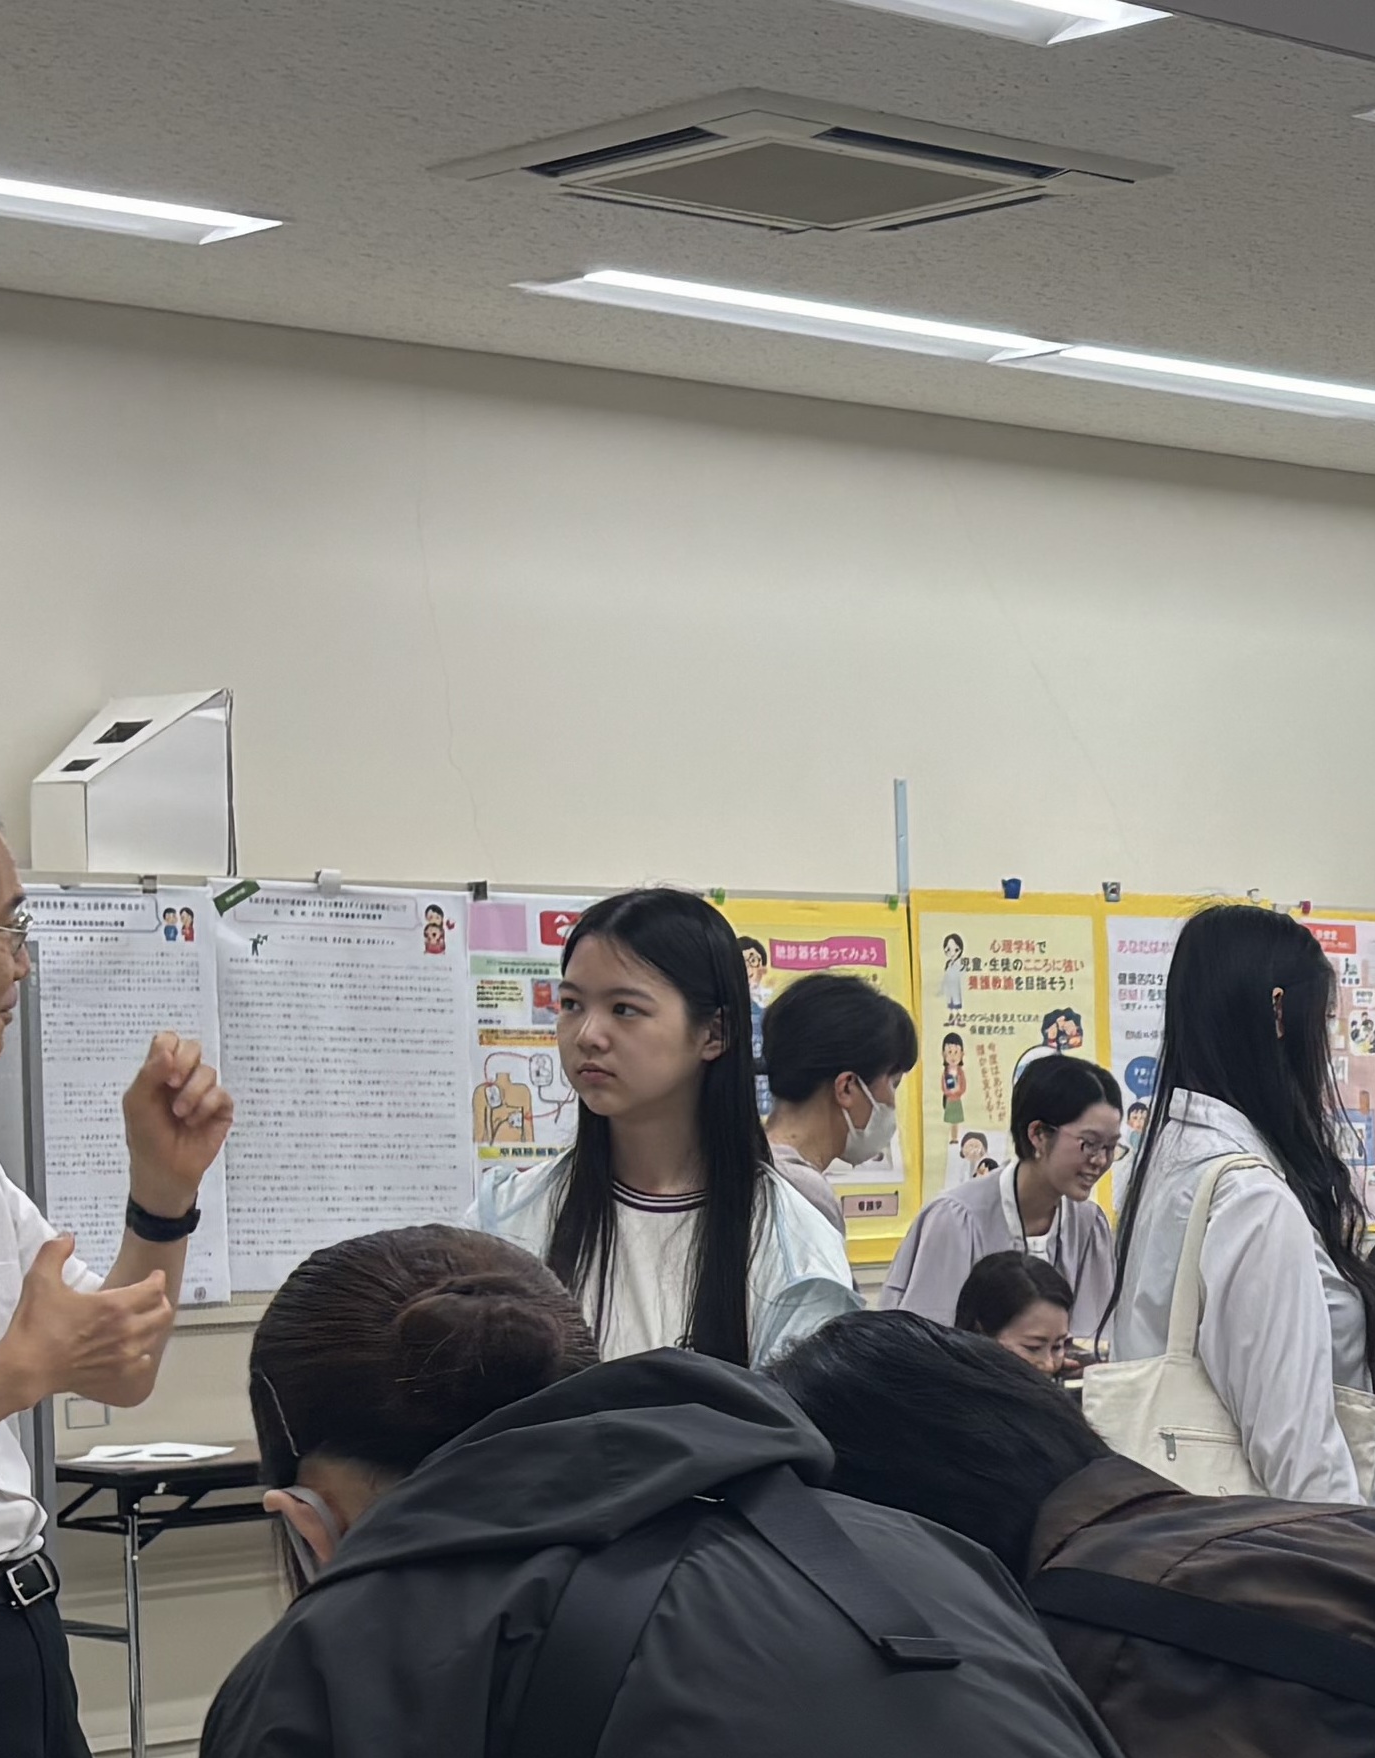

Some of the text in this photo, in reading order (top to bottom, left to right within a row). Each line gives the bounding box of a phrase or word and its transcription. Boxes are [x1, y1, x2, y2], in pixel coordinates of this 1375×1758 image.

[775, 944, 878, 962] 聴診器を使ってみよう
[990, 939, 1046, 954] 心理学科で
